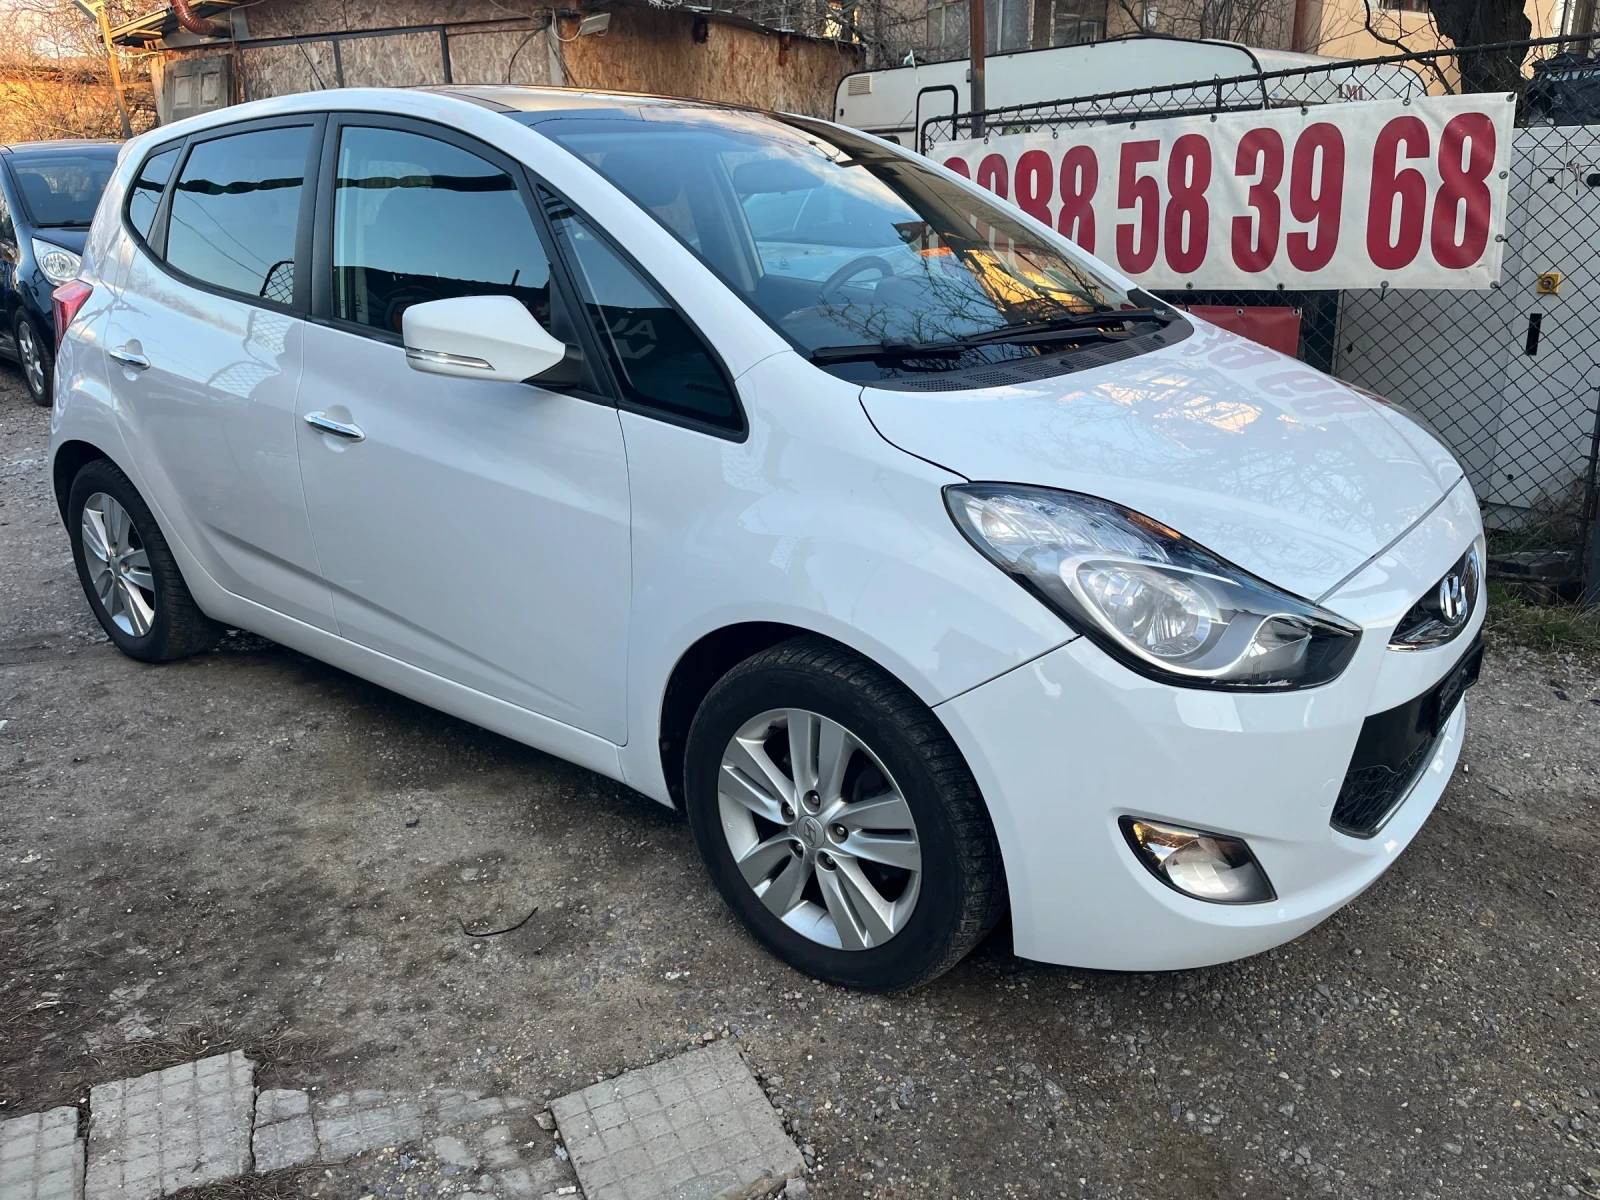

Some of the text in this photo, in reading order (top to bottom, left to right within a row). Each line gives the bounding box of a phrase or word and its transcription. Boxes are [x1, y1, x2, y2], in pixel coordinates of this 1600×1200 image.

[943, 112, 1496, 274] 88 58 39 68
